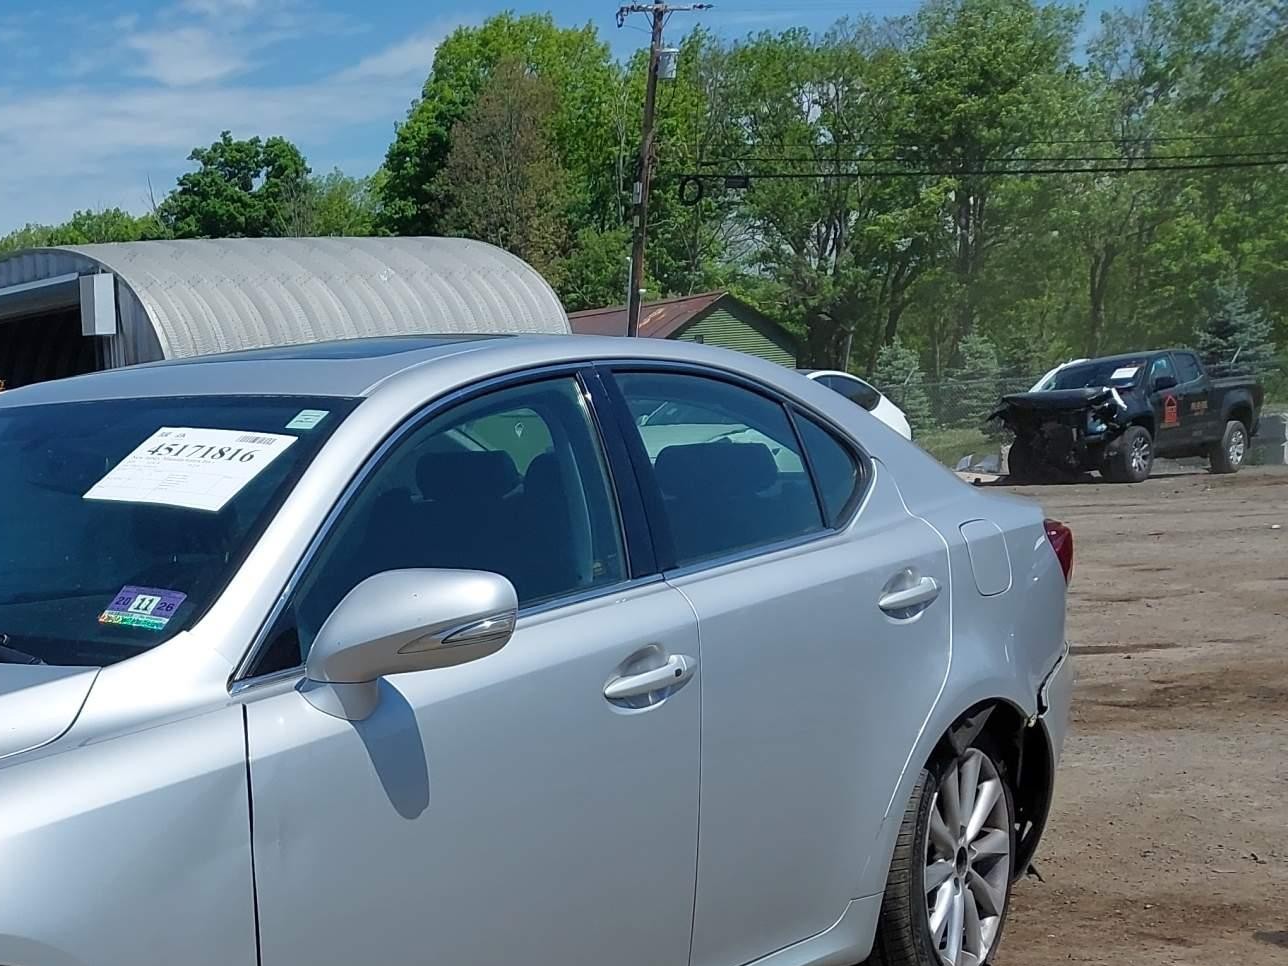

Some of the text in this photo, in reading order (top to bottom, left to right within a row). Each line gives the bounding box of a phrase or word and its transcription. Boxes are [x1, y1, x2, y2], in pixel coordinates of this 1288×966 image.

[148, 443, 261, 463] 45171816
[115, 596, 175, 612] 20 11 26
